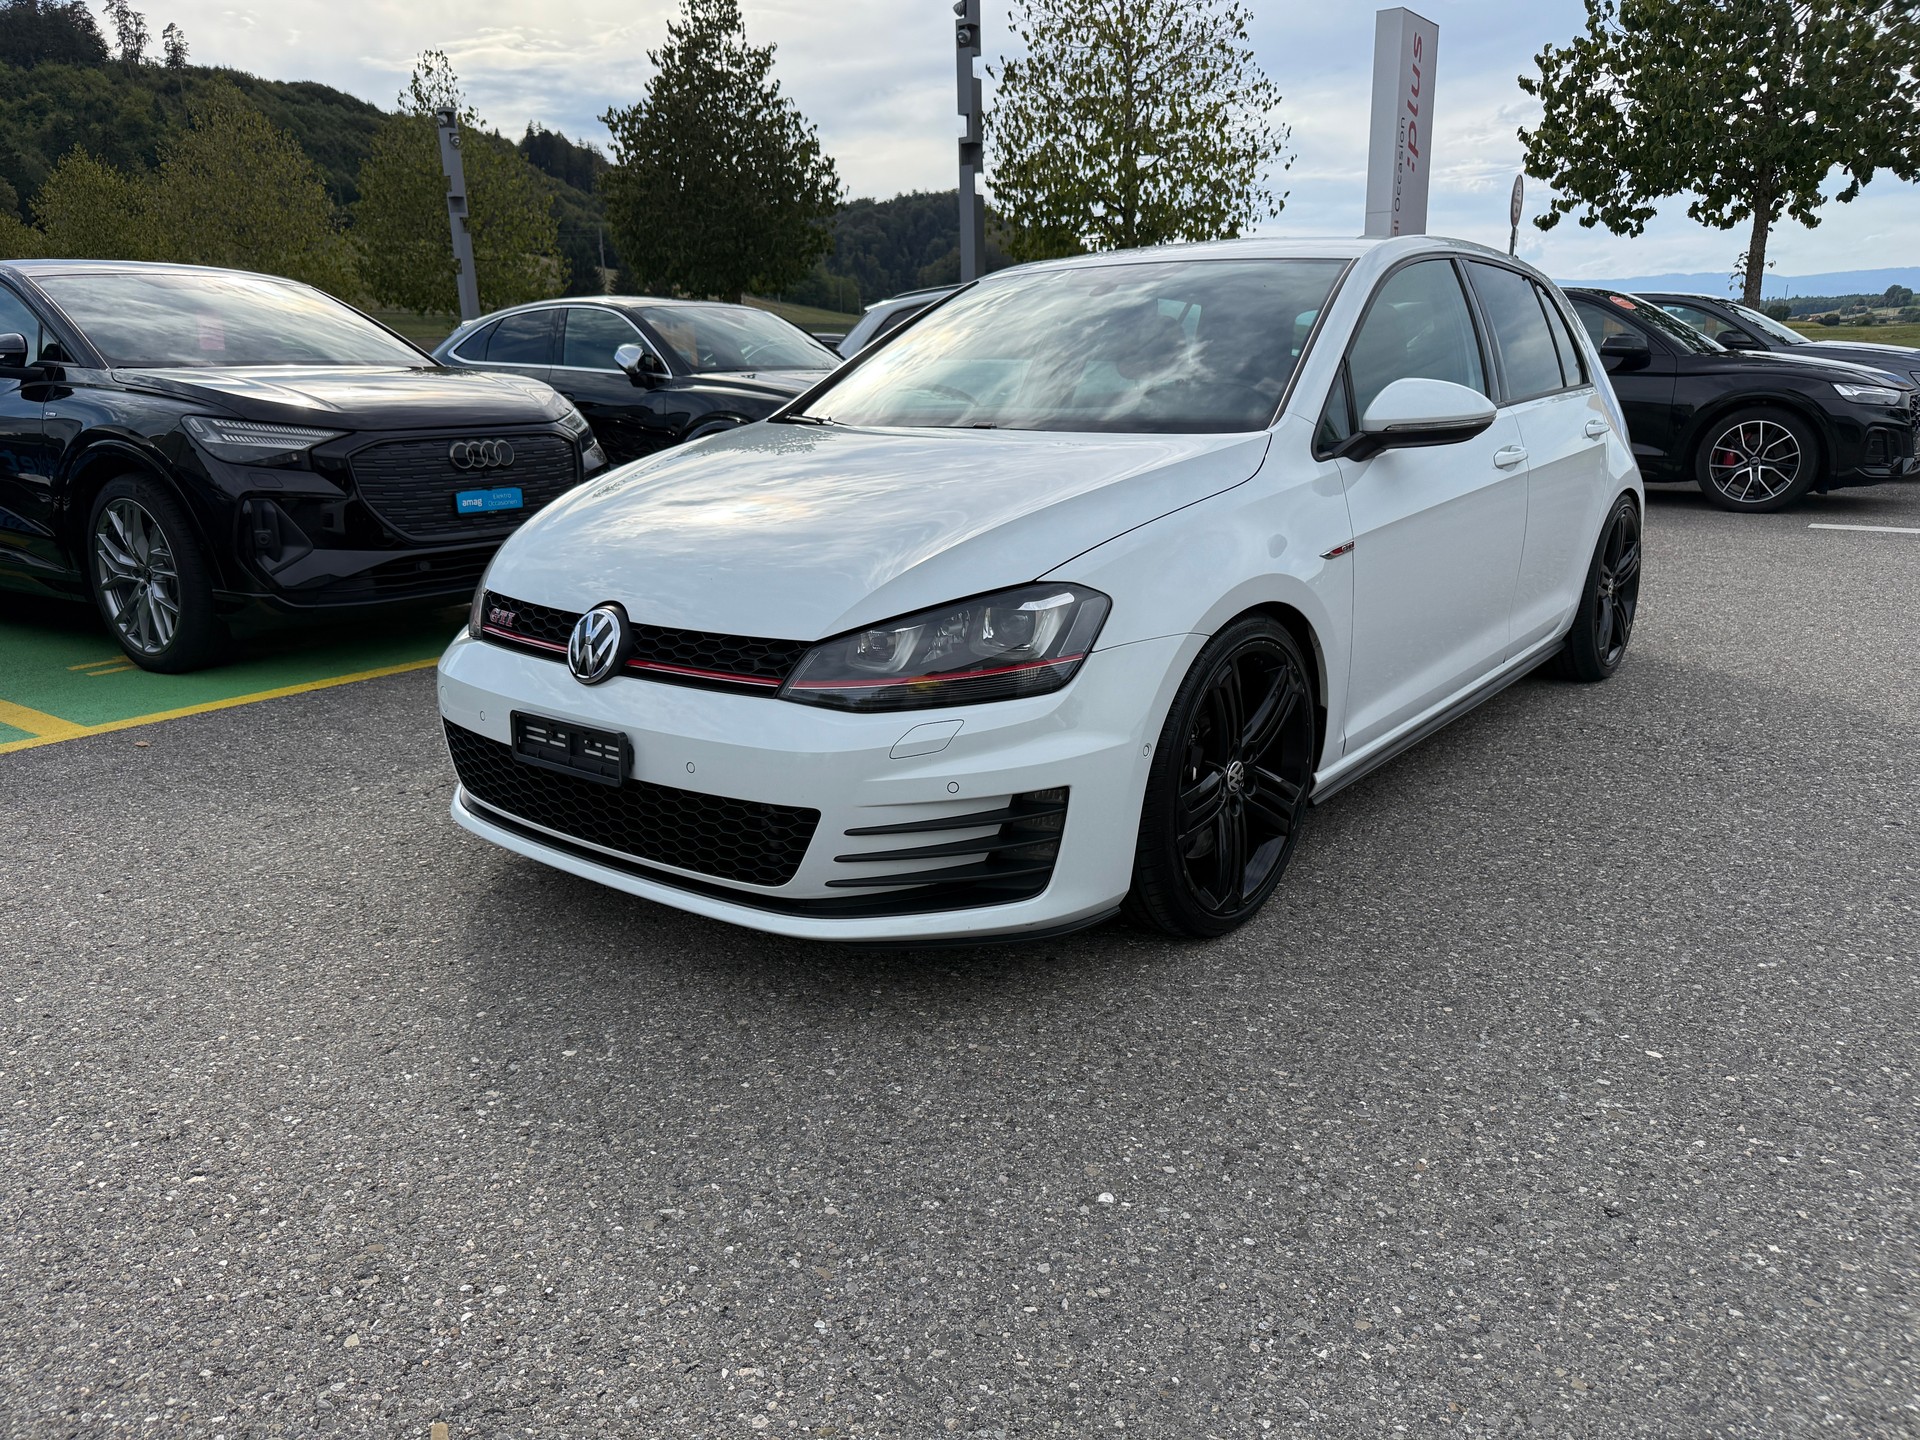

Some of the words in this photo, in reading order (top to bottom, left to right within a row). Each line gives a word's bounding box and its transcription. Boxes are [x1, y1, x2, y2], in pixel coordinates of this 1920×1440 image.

[1394, 117, 1406, 212] Occasion
[462, 498, 483, 507] amag
[490, 607, 515, 627] GTI
